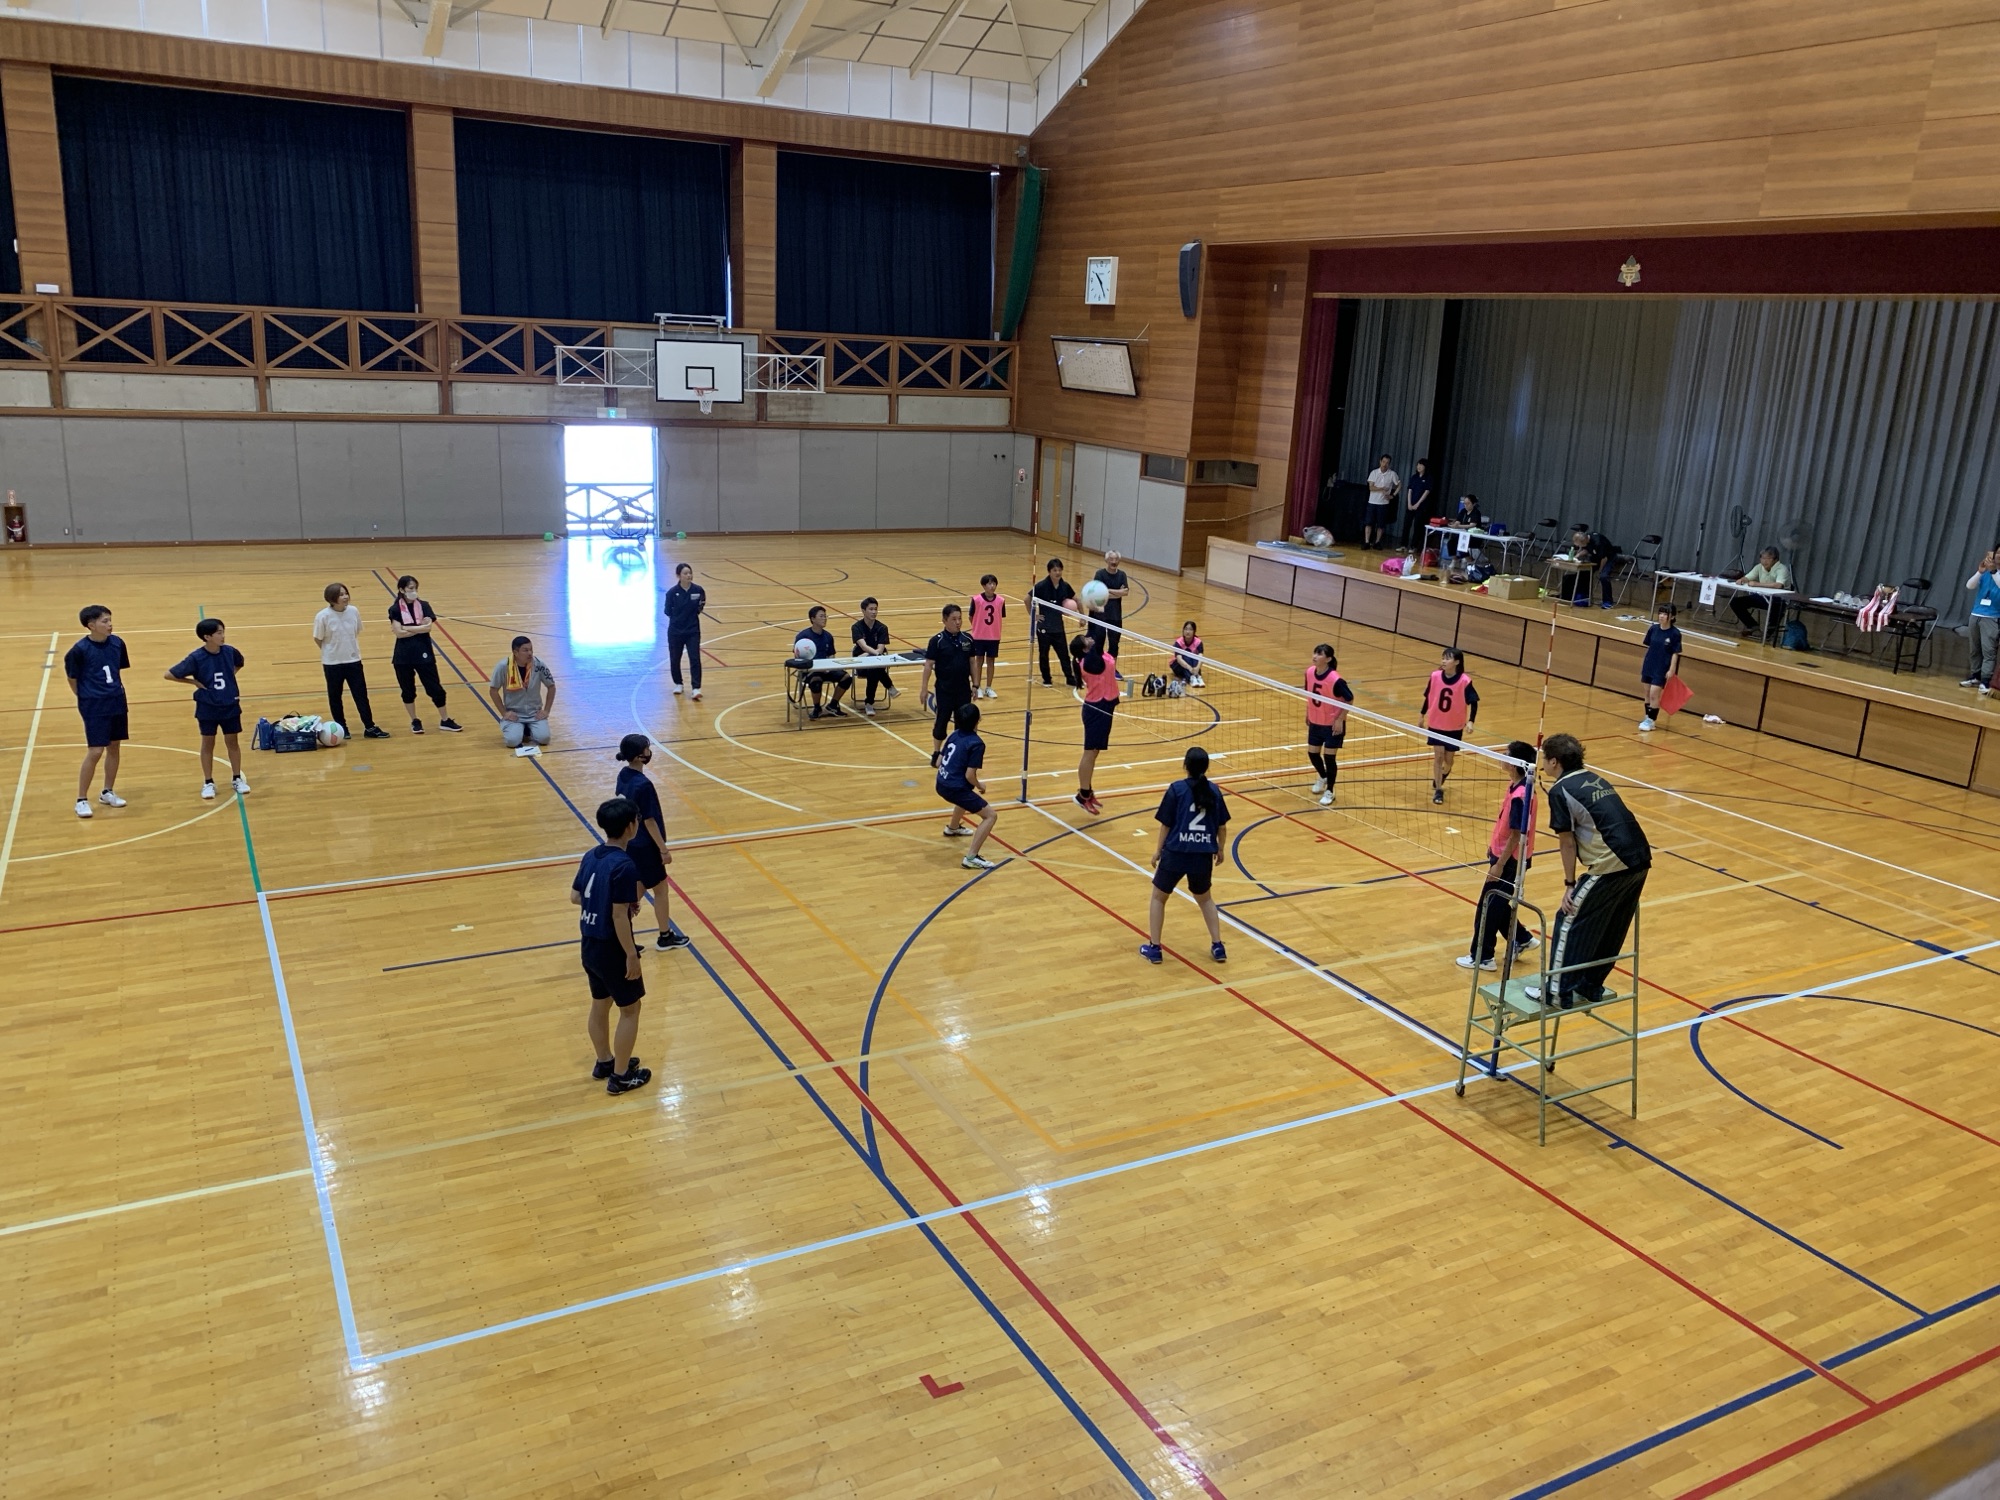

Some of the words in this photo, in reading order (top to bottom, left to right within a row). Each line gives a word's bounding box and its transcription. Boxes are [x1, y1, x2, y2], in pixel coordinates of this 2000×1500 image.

[984, 605, 995, 626] 3
[102, 665, 113, 683] 1
[213, 672, 225, 689] 5
[1311, 683, 1322, 707] 5
[1438, 687, 1453, 712] 6
[941, 742, 956, 766] 3
[1188, 802, 1206, 830] 2
[1179, 832, 1211, 843] MACHI
